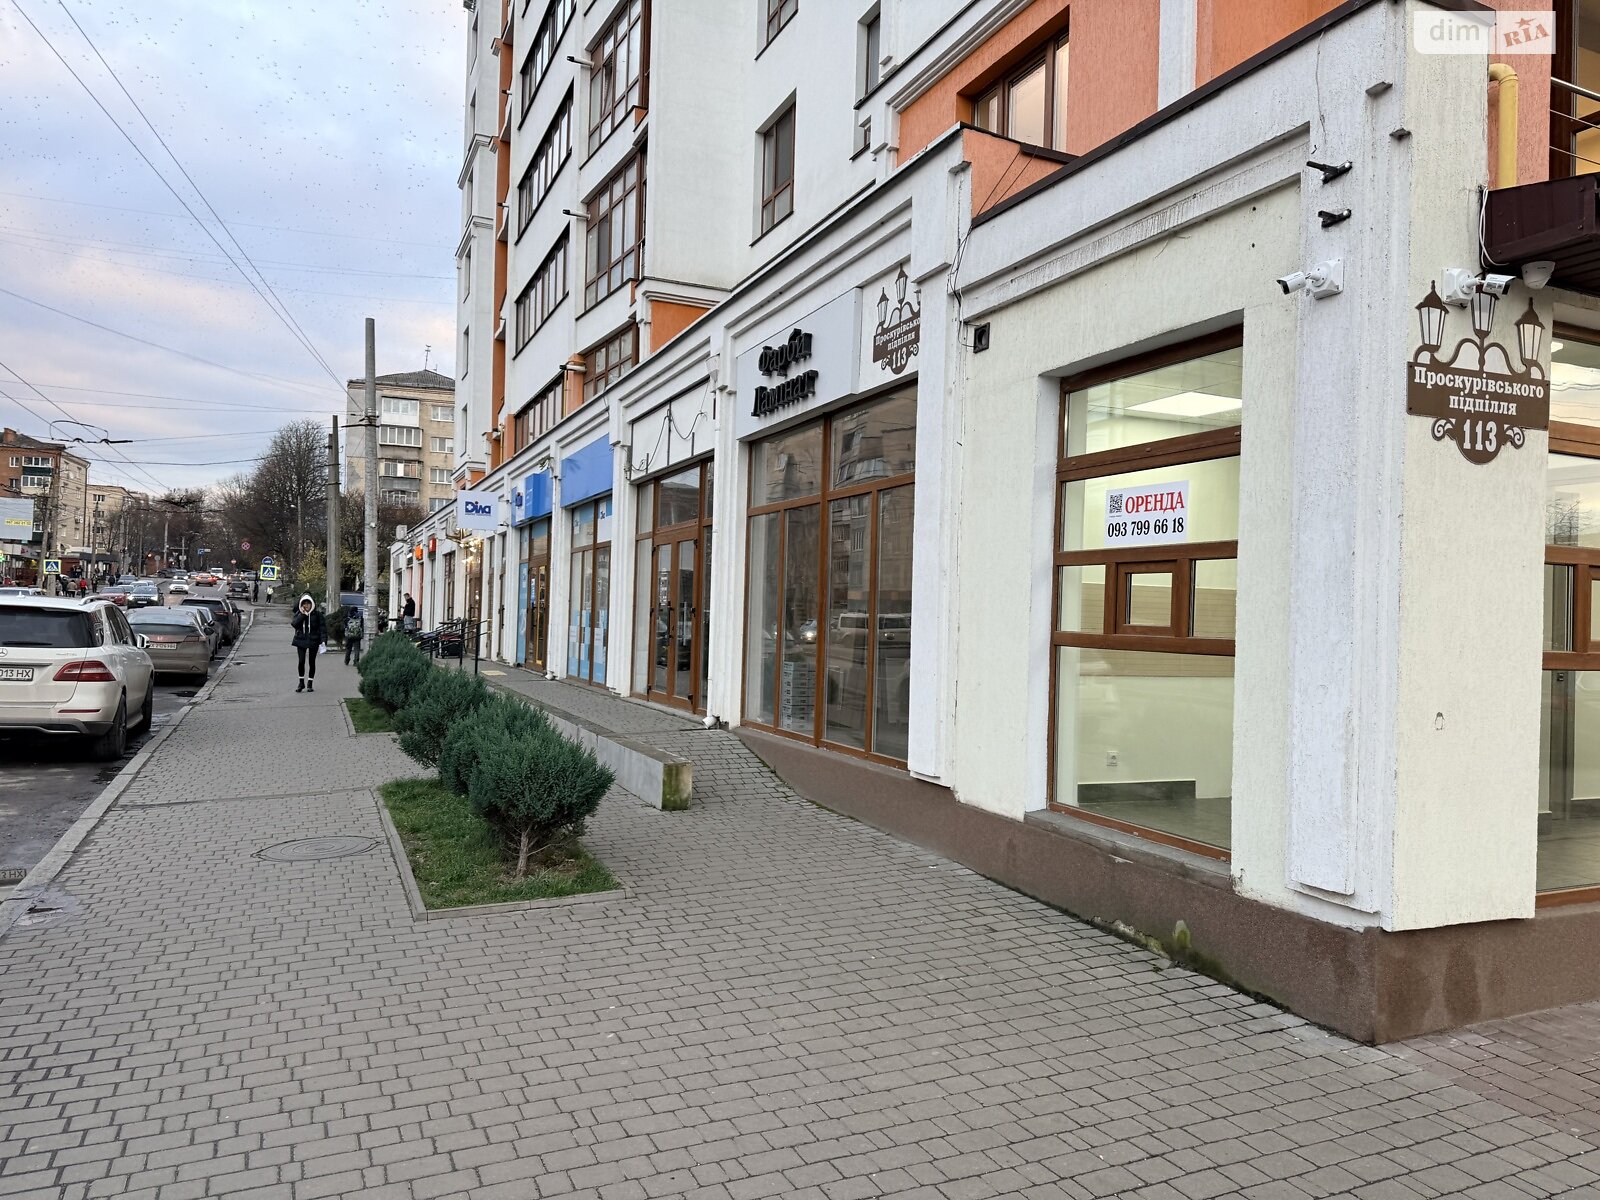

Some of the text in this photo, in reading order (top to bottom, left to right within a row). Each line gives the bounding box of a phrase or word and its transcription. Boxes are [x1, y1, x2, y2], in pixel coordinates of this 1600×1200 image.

[887, 331, 916, 350] підпілля
[892, 346, 907, 369] 113
[1414, 366, 1544, 399] Проскурівського
[1448, 390, 1517, 416] підпілля
[1463, 419, 1497, 453] 113
[1125, 490, 1185, 514] ОРЕНДА
[1107, 517, 1184, 538] 093 799 66 18
[16, 669, 31, 678] HX
